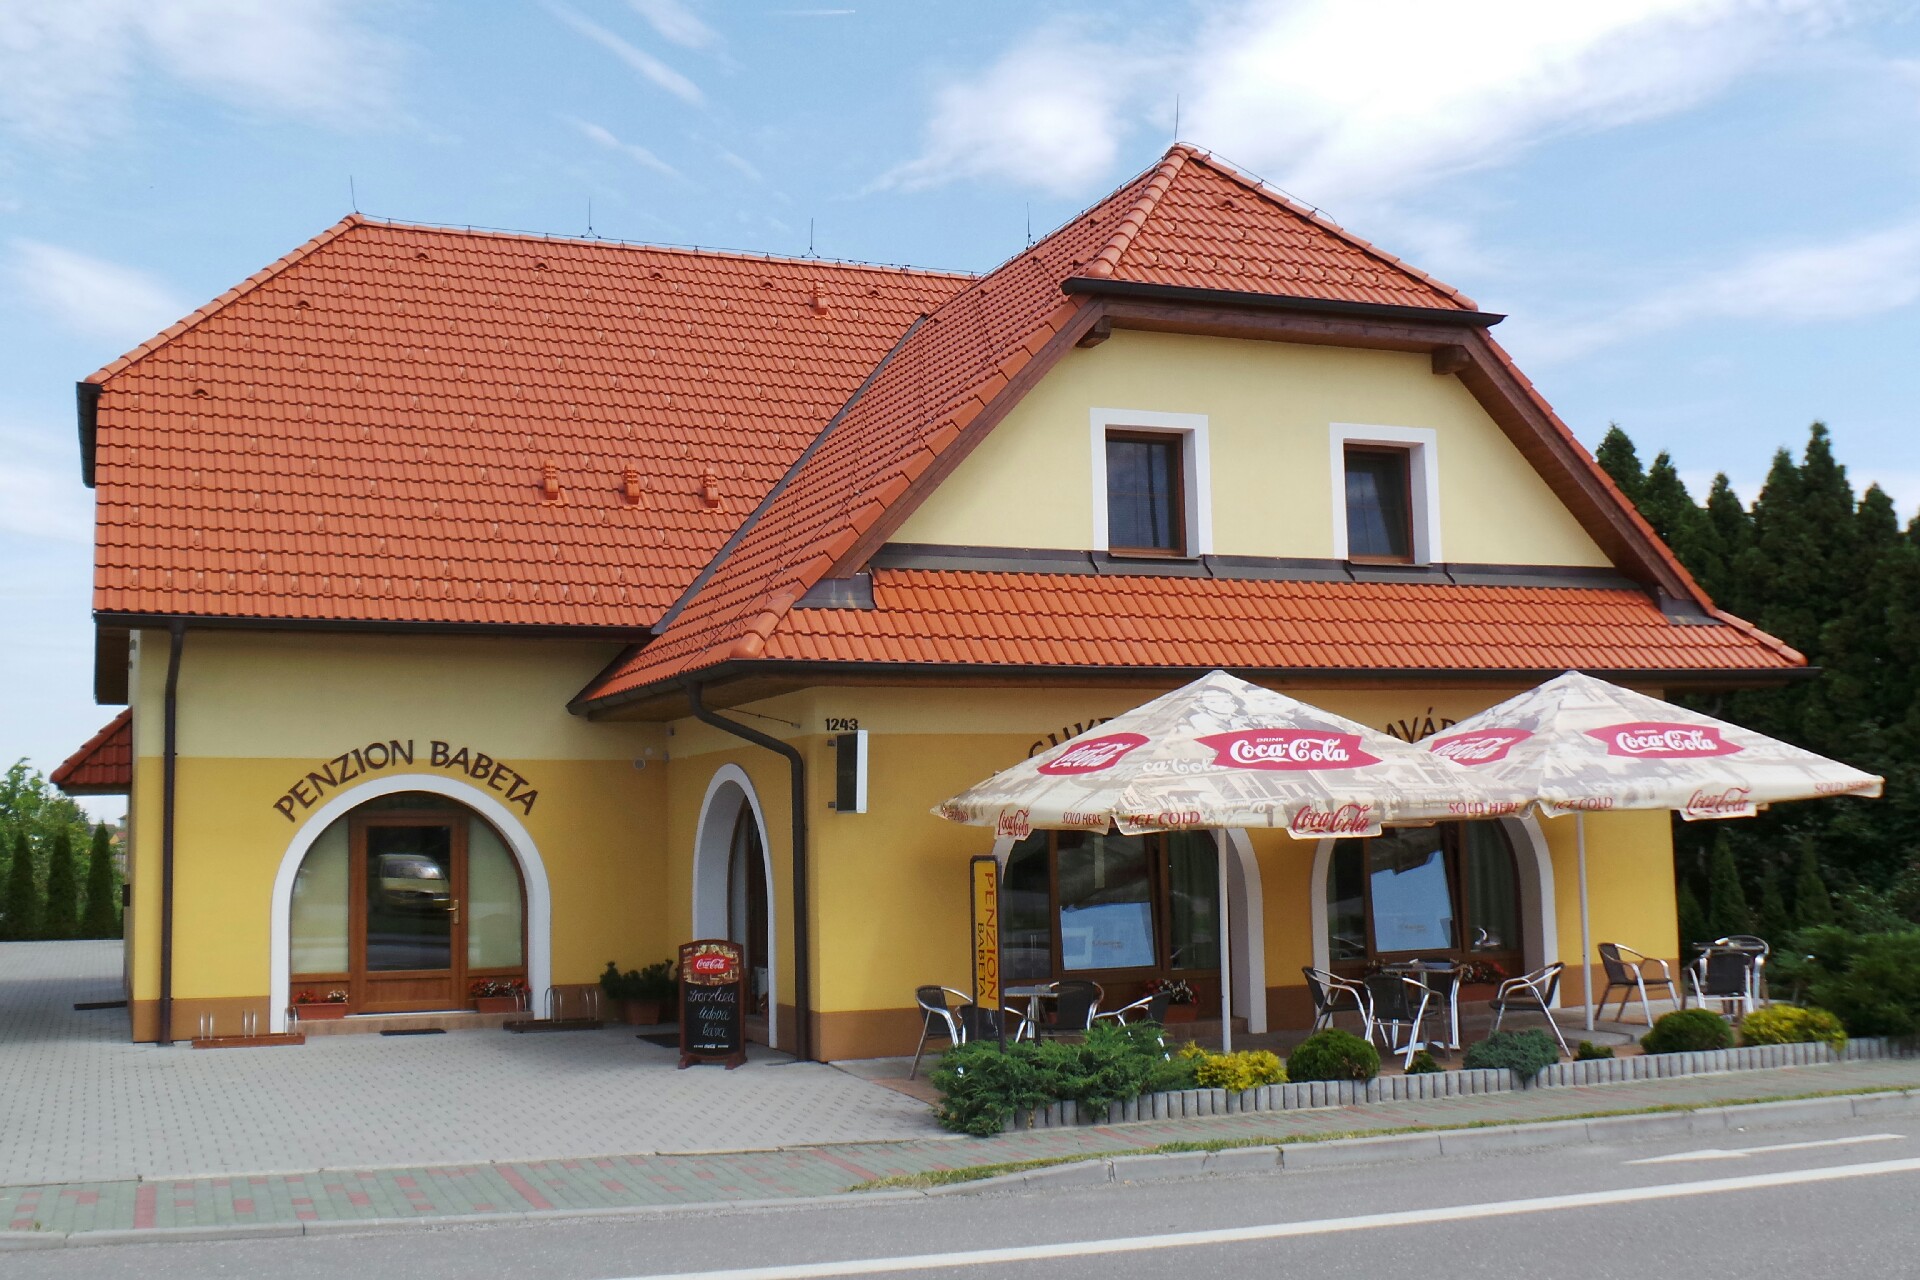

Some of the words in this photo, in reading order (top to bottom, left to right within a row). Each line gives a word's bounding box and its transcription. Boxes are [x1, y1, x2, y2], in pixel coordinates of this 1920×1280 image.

[825, 718, 858, 731] 1243
[1230, 738, 1349, 763] Coca-Cola
[1616, 730, 1718, 754] Coca-Cola
[273, 739, 413, 823] PENZION
[430, 740, 539, 816] BABETA
[1449, 802, 1484, 814] SOLD
[1489, 802, 1520, 815] HERE
[1578, 797, 1613, 811] COLD
[1062, 812, 1081, 824] SOLD
[1083, 813, 1104, 826] HERE
[1158, 811, 1200, 826] COLD
[1292, 804, 1371, 833] Coca-Cola
[985, 872, 997, 1001] PENZION
[977, 922, 986, 997] BABETA
